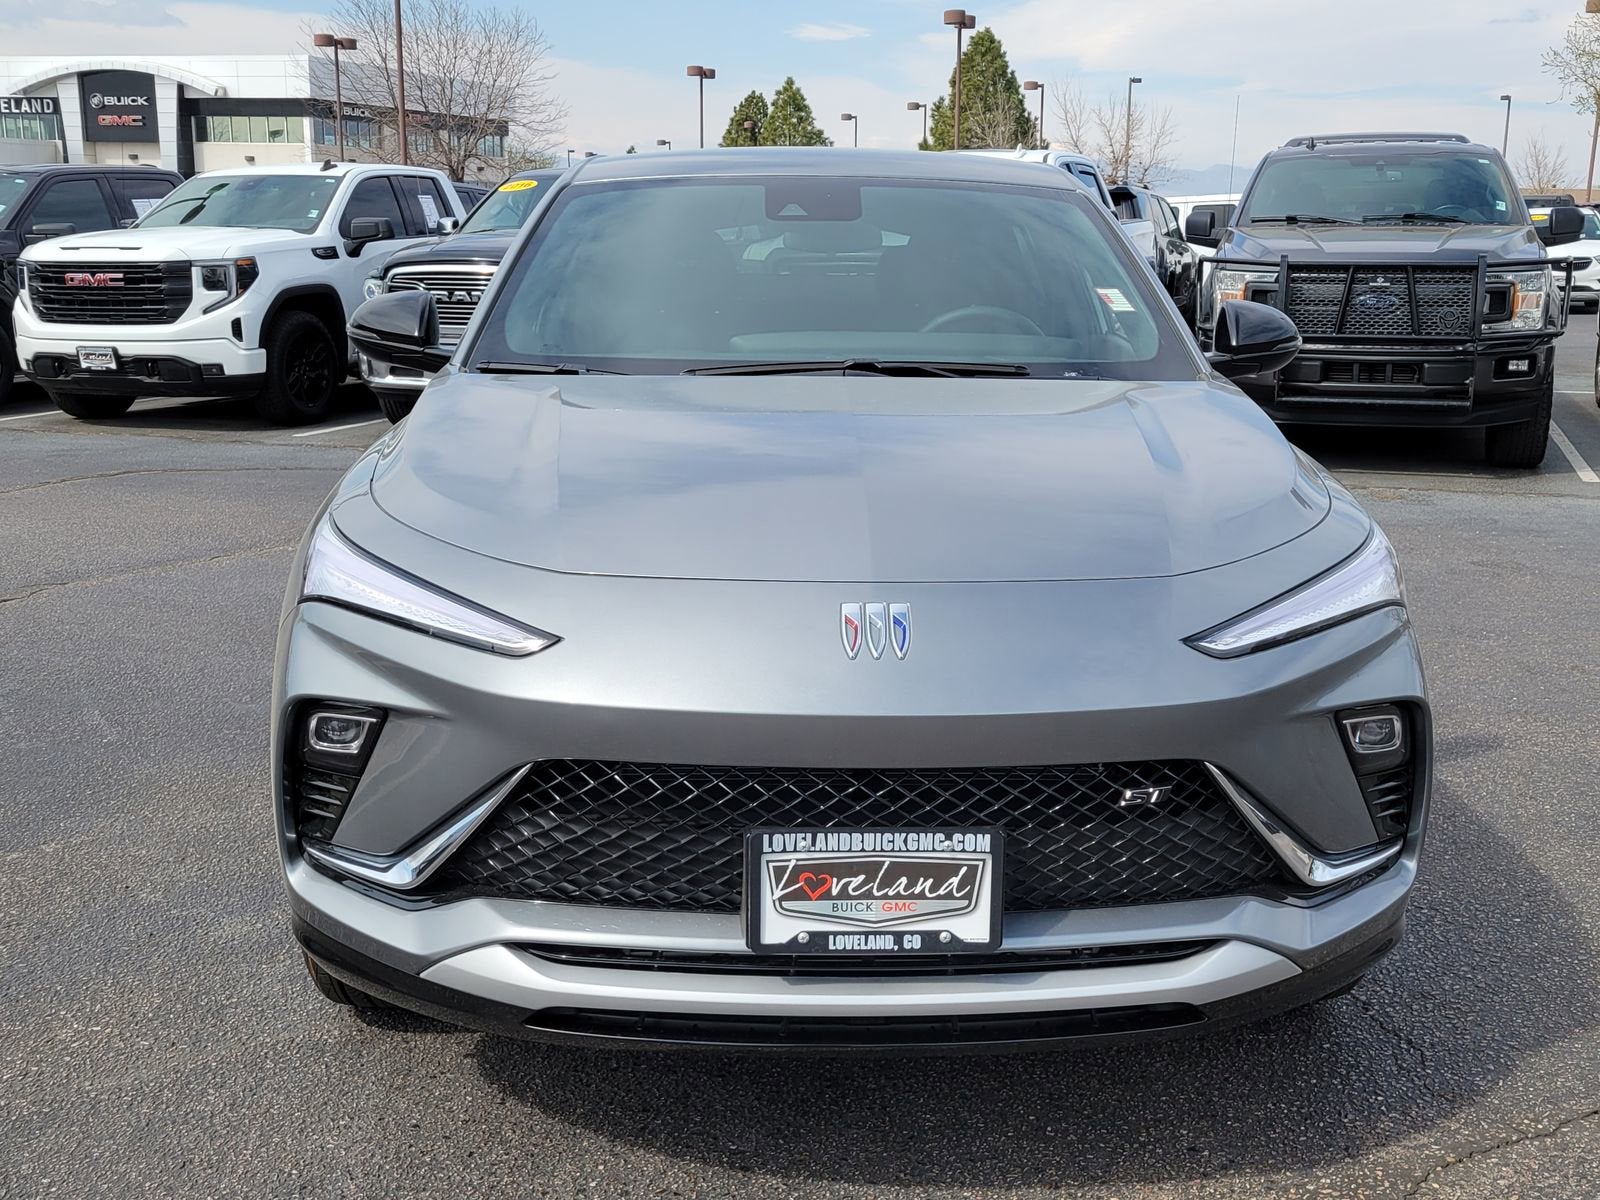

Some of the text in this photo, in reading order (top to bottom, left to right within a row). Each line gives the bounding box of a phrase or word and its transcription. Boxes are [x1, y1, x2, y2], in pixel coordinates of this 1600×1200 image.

[0, 98, 54, 113] ELAND
[104, 96, 150, 106] BUICK
[98, 115, 143, 126] GMC
[65, 273, 125, 287] GMC
[1120, 786, 1172, 806] ST
[762, 832, 991, 853] LOVELANDBUICKGMCCOM
[772, 859, 971, 902] Loveland
[831, 901, 918, 913] BUICK GMC
[828, 934, 922, 951] LOVELAND, CO
